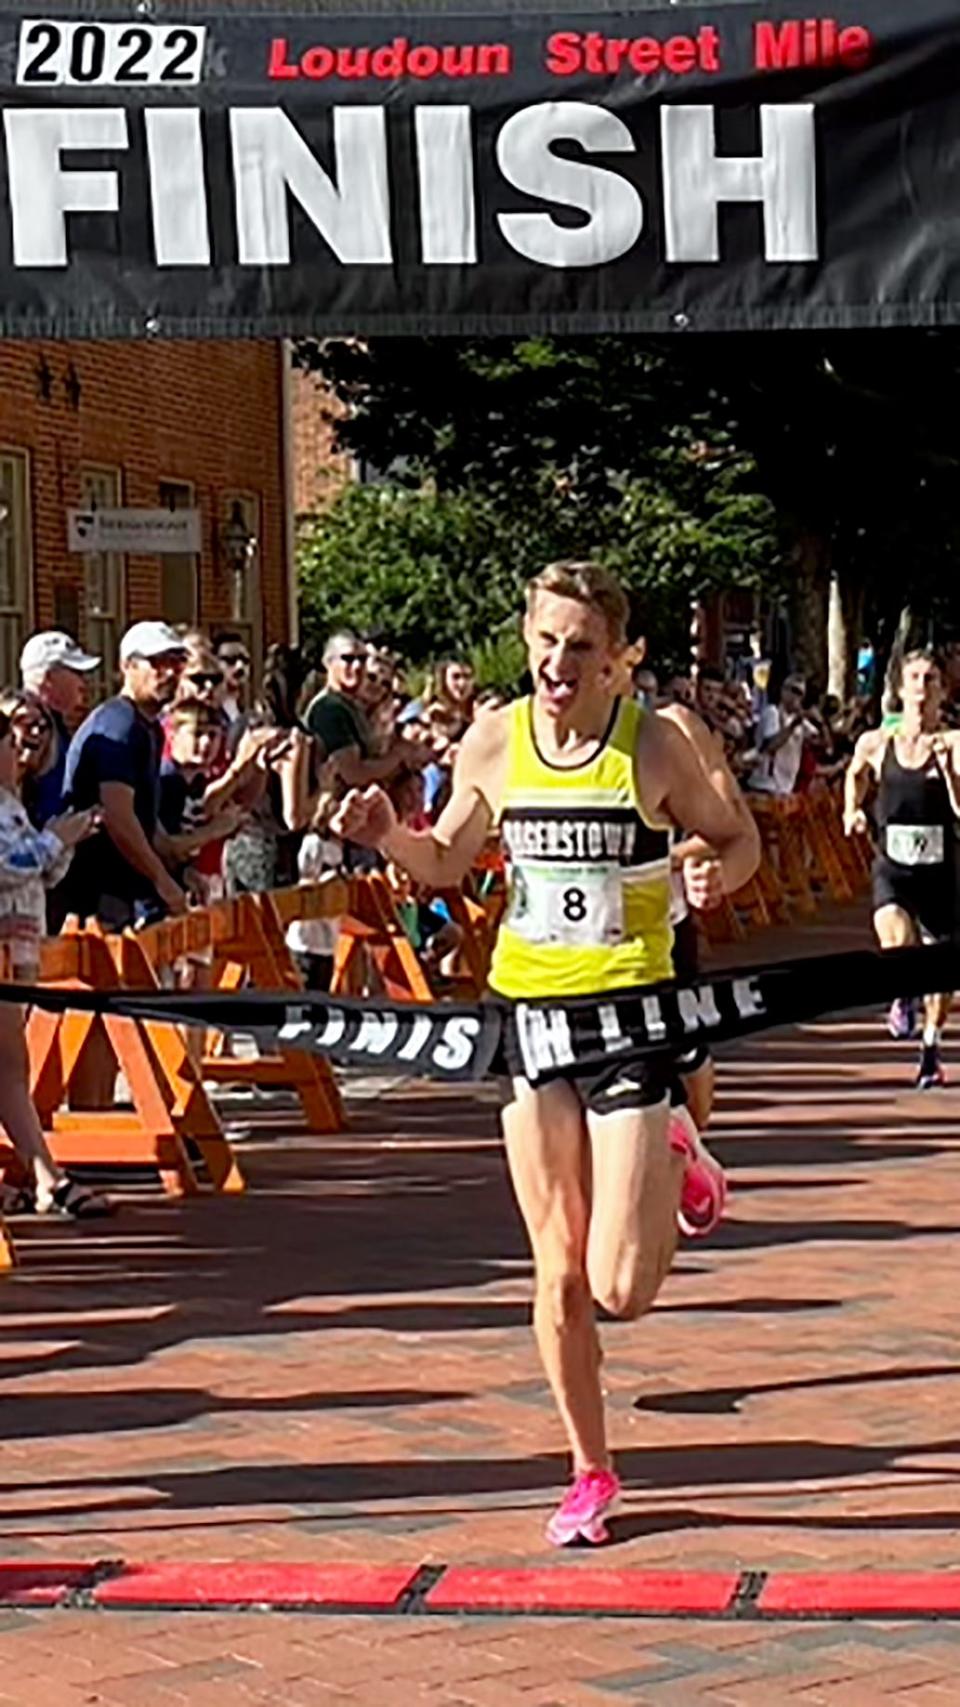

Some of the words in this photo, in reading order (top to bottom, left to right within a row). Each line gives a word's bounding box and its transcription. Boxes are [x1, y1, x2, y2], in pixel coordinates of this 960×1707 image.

[23, 23, 198, 82] 2022
[267, 37, 511, 79] Loudoun
[545, 26, 720, 75] Street
[753, 19, 872, 70] Mile
[3, 102, 819, 267] FINISH
[562, 886, 588, 922] 8
[597, 976, 767, 1053] LINE
